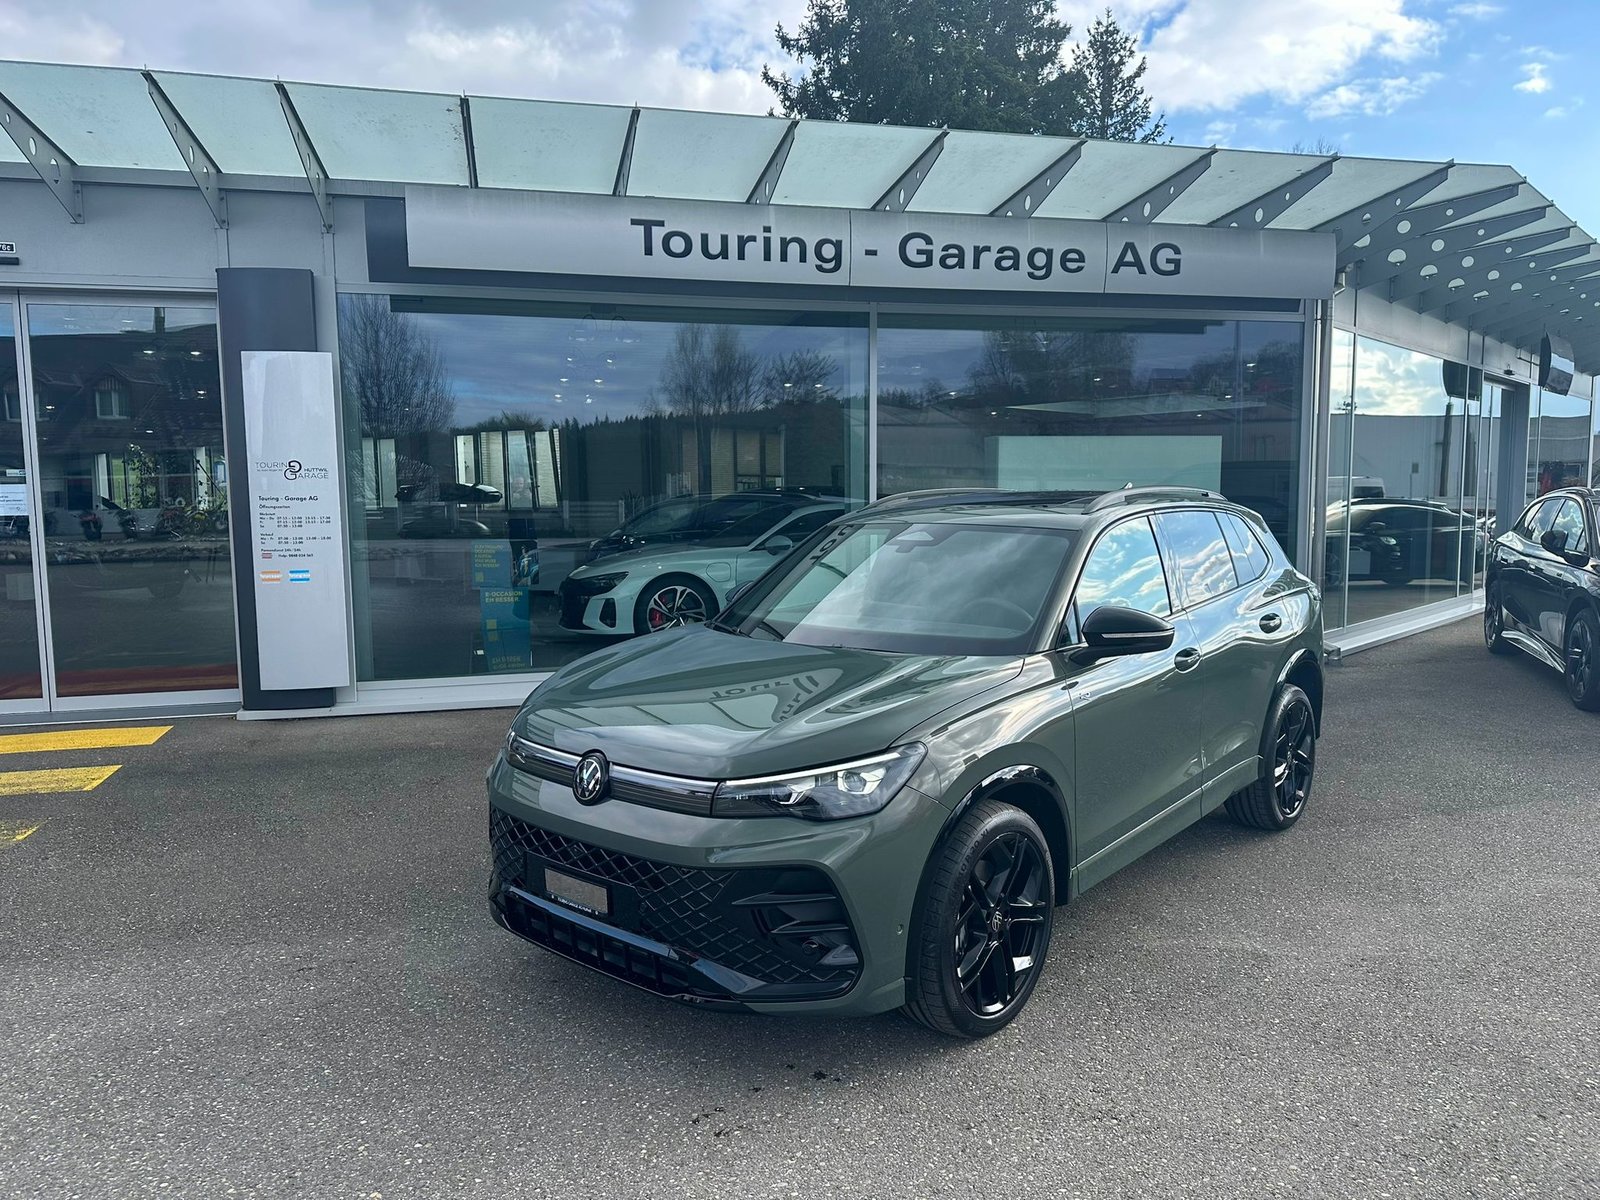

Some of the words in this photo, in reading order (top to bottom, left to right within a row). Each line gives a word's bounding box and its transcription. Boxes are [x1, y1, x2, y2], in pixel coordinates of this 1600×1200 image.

[630, 218, 842, 274] Touring
[898, 232, 1086, 280] Garage
[1110, 242, 1182, 276] AG
